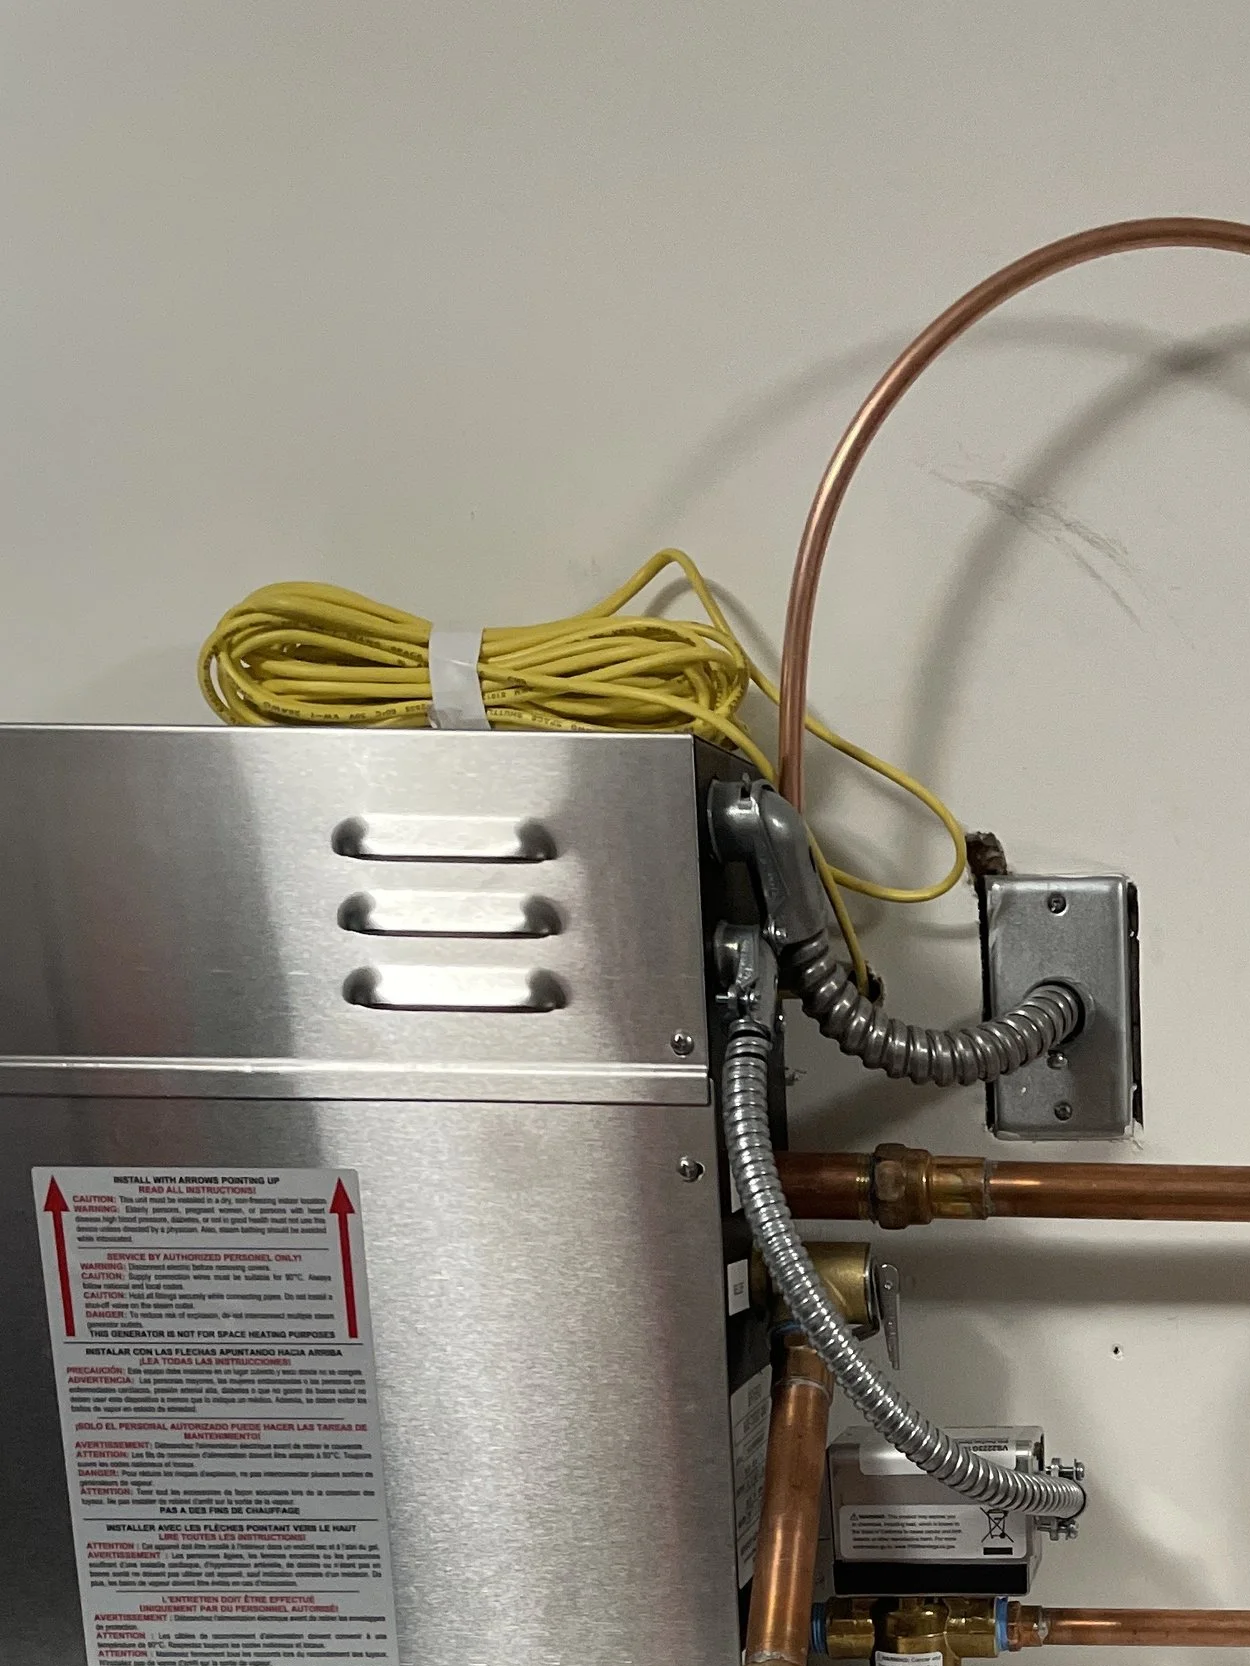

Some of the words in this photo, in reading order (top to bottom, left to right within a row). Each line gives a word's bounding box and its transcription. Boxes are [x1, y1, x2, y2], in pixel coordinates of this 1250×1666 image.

[114, 1176, 150, 1184] INSTALL
[154, 1176, 176, 1184] WITH
[179, 1176, 218, 1184] ARROWS
[139, 1186, 164, 1194] READ
[166, 1186, 184, 1194] ALL
[186, 1186, 256, 1194] INSTRUCTIONS!
[73, 1195, 116, 1203] CAUTION:
[74, 1205, 119, 1213] WARNING:
[107, 1253, 146, 1261] SERVICE
[149, 1253, 162, 1261] BY
[81, 1272, 125, 1280] CAUTION:
[86, 1311, 127, 1319] DANGER:
[289, 1331, 336, 1339] PURPOSES
[155, 1348, 173, 1356] LAS
[175, 1348, 216, 1356] FLECHAS
[308, 1349, 343, 1357] ARRIBA
[67, 1366, 125, 1374] PRECAUCIÓN:
[68, 1376, 134, 1384] ADVERTENCIA:
[170, 1423, 228, 1431] AUTORIZADO
[231, 1423, 261, 1431] PUEDE
[264, 1423, 295, 1431] HACER
[246, 1507, 300, 1515] CHAUFFAGE
[106, 1524, 155, 1532] INSTALLER
[244, 1595, 267, 1603] ÊTRE
[200, 1605, 218, 1613] PAR
[221, 1605, 233, 1613] DU
[236, 1605, 289, 1613] PERSONNEL
